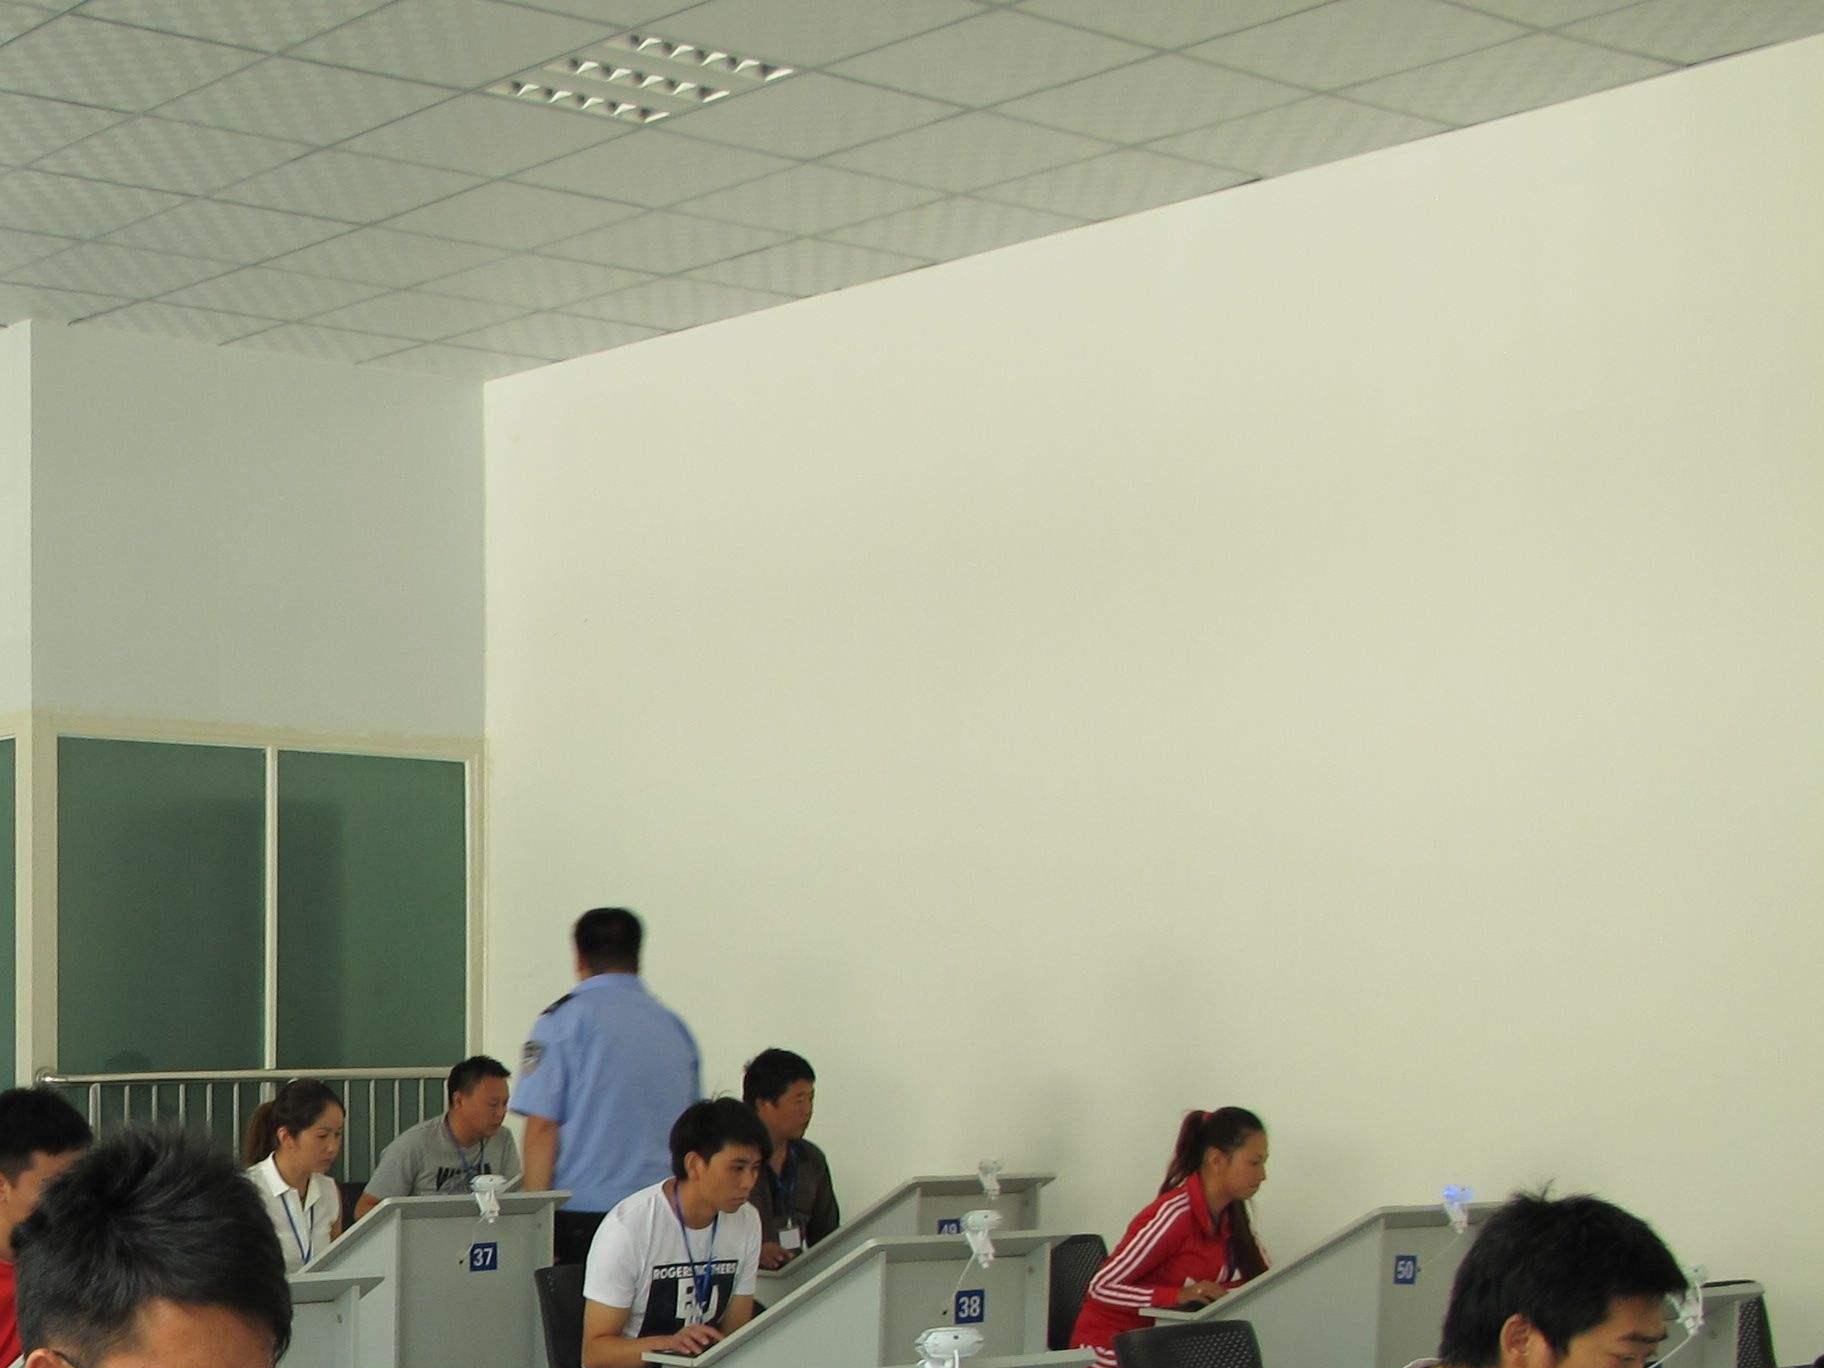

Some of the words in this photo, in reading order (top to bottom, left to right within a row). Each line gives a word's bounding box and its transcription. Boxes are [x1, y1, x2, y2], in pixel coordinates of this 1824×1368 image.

[473, 1248, 494, 1267] 37
[1397, 1260, 1414, 1279] 50
[959, 1296, 981, 1317] 38
